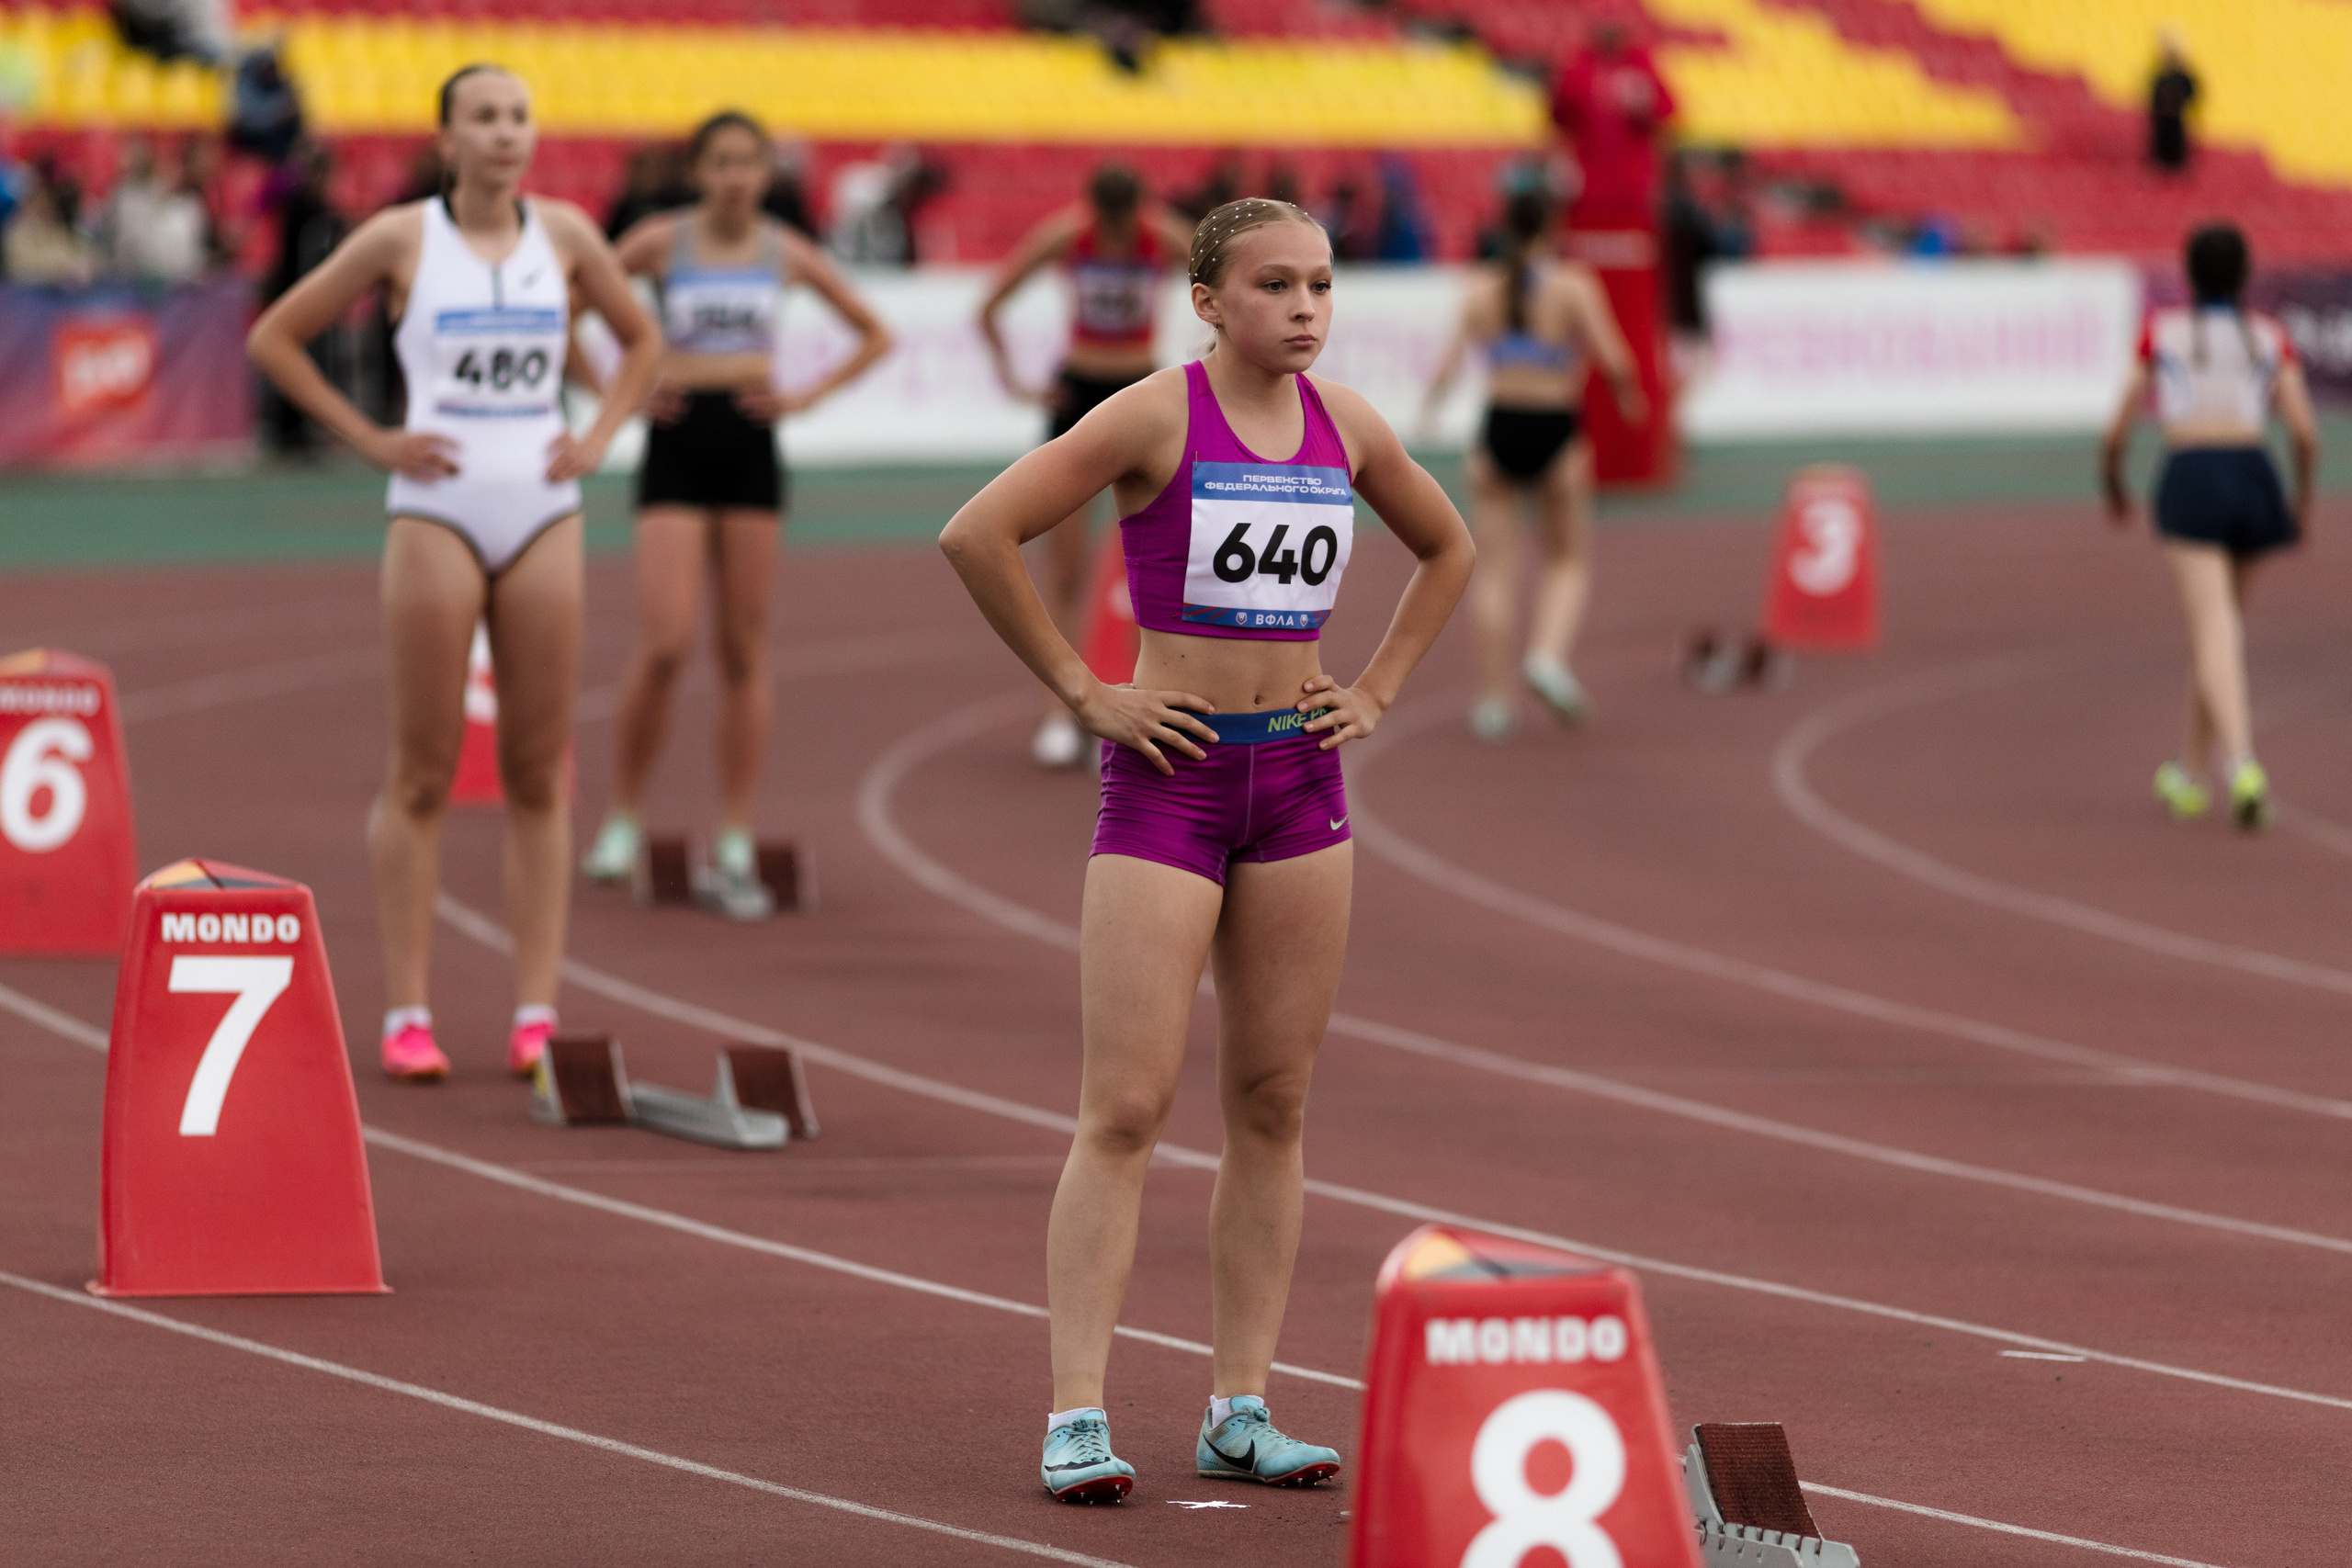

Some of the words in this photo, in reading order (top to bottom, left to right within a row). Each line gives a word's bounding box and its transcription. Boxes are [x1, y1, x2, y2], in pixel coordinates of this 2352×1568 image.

[454, 346, 549, 391] 480
[1204, 482, 1309, 493] ФЕДЕРАЛЬНОГО
[1310, 486, 1346, 496] ОКРУГА
[1243, 474, 1321, 485] ПЕРВЕНСТВО
[1213, 522, 1338, 586] 640
[1788, 498, 1862, 595] 3
[1255, 614, 1295, 626] ВФЛА
[1268, 713, 1306, 732] NIKE
[0, 716, 95, 855] 6
[161, 912, 300, 943] MONDO
[167, 954, 295, 1137] 7
[1427, 1316, 1625, 1364] MONDO
[1460, 1389, 1627, 1568] 8
